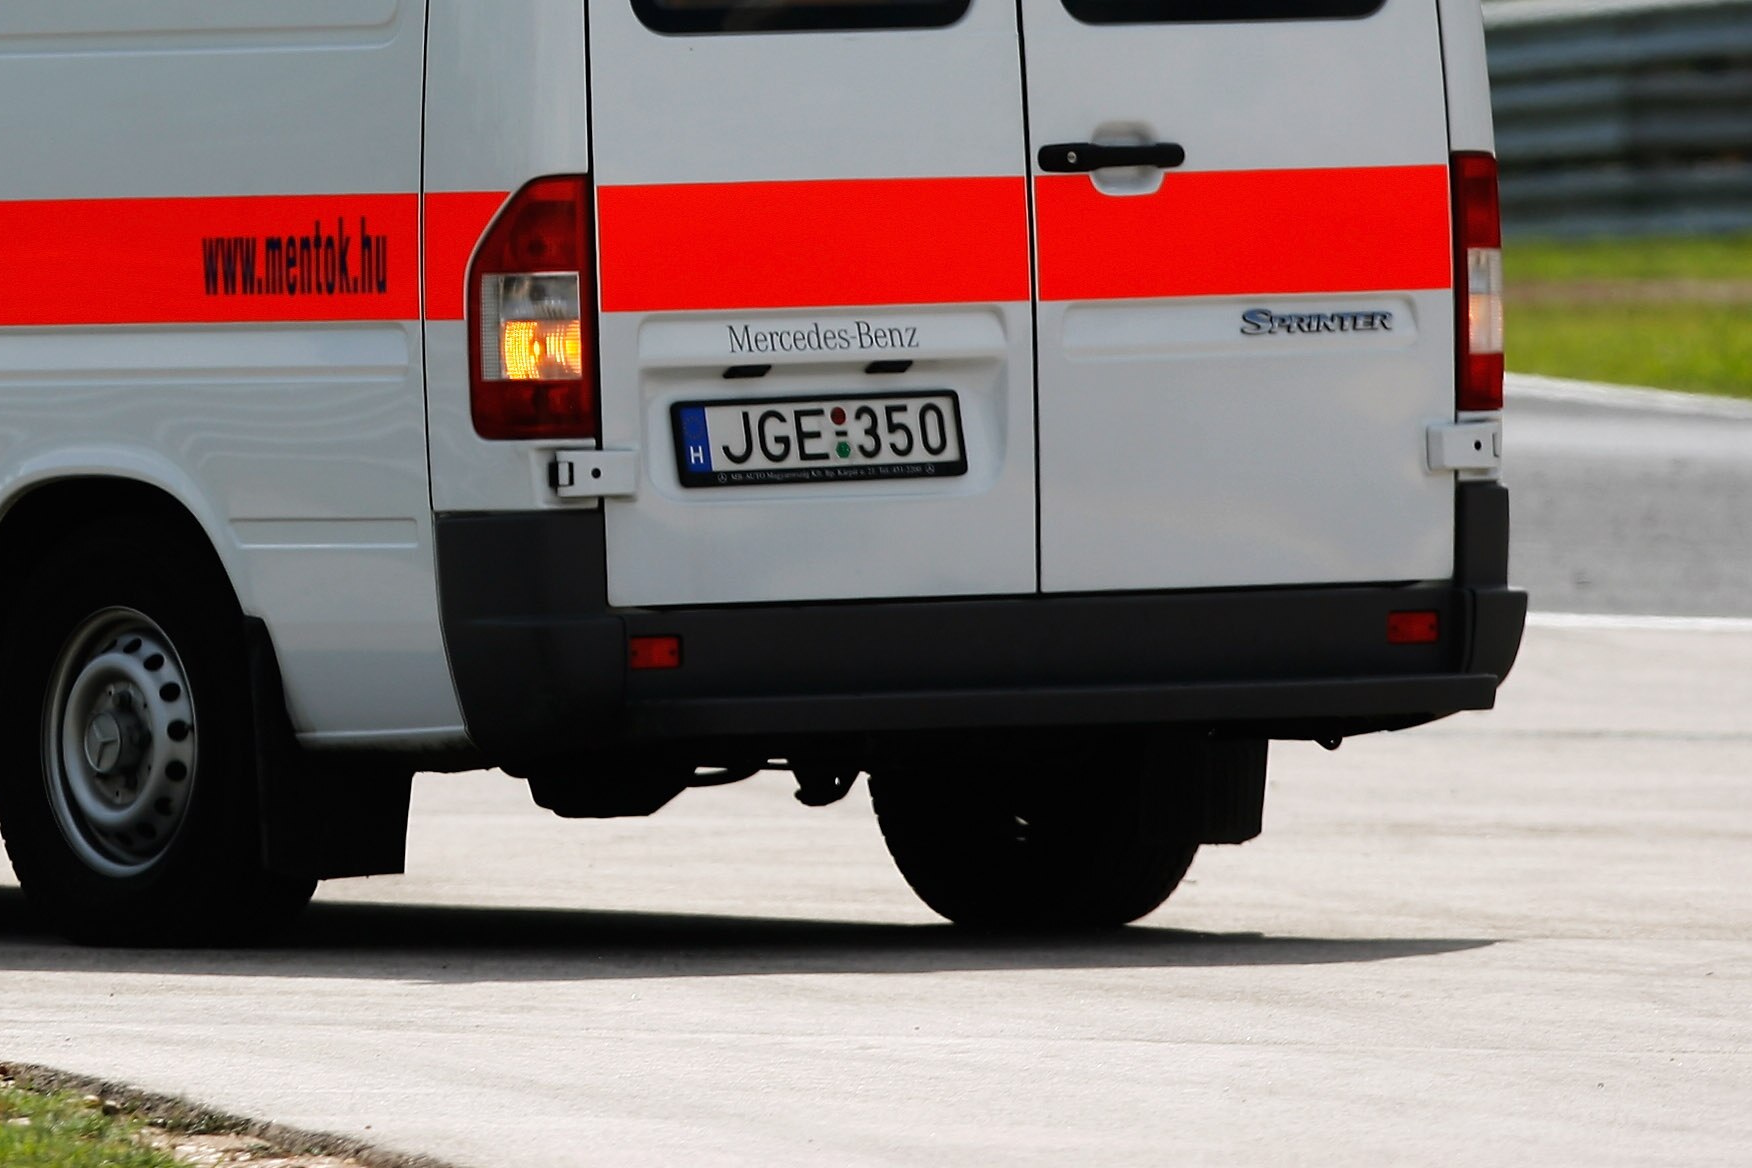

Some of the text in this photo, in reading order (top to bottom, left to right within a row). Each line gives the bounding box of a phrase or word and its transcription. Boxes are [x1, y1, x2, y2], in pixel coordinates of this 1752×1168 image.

[201, 216, 387, 296] www.mentok.hu
[727, 319, 920, 354] Mercedes-Benz
[689, 445, 704, 465] H
